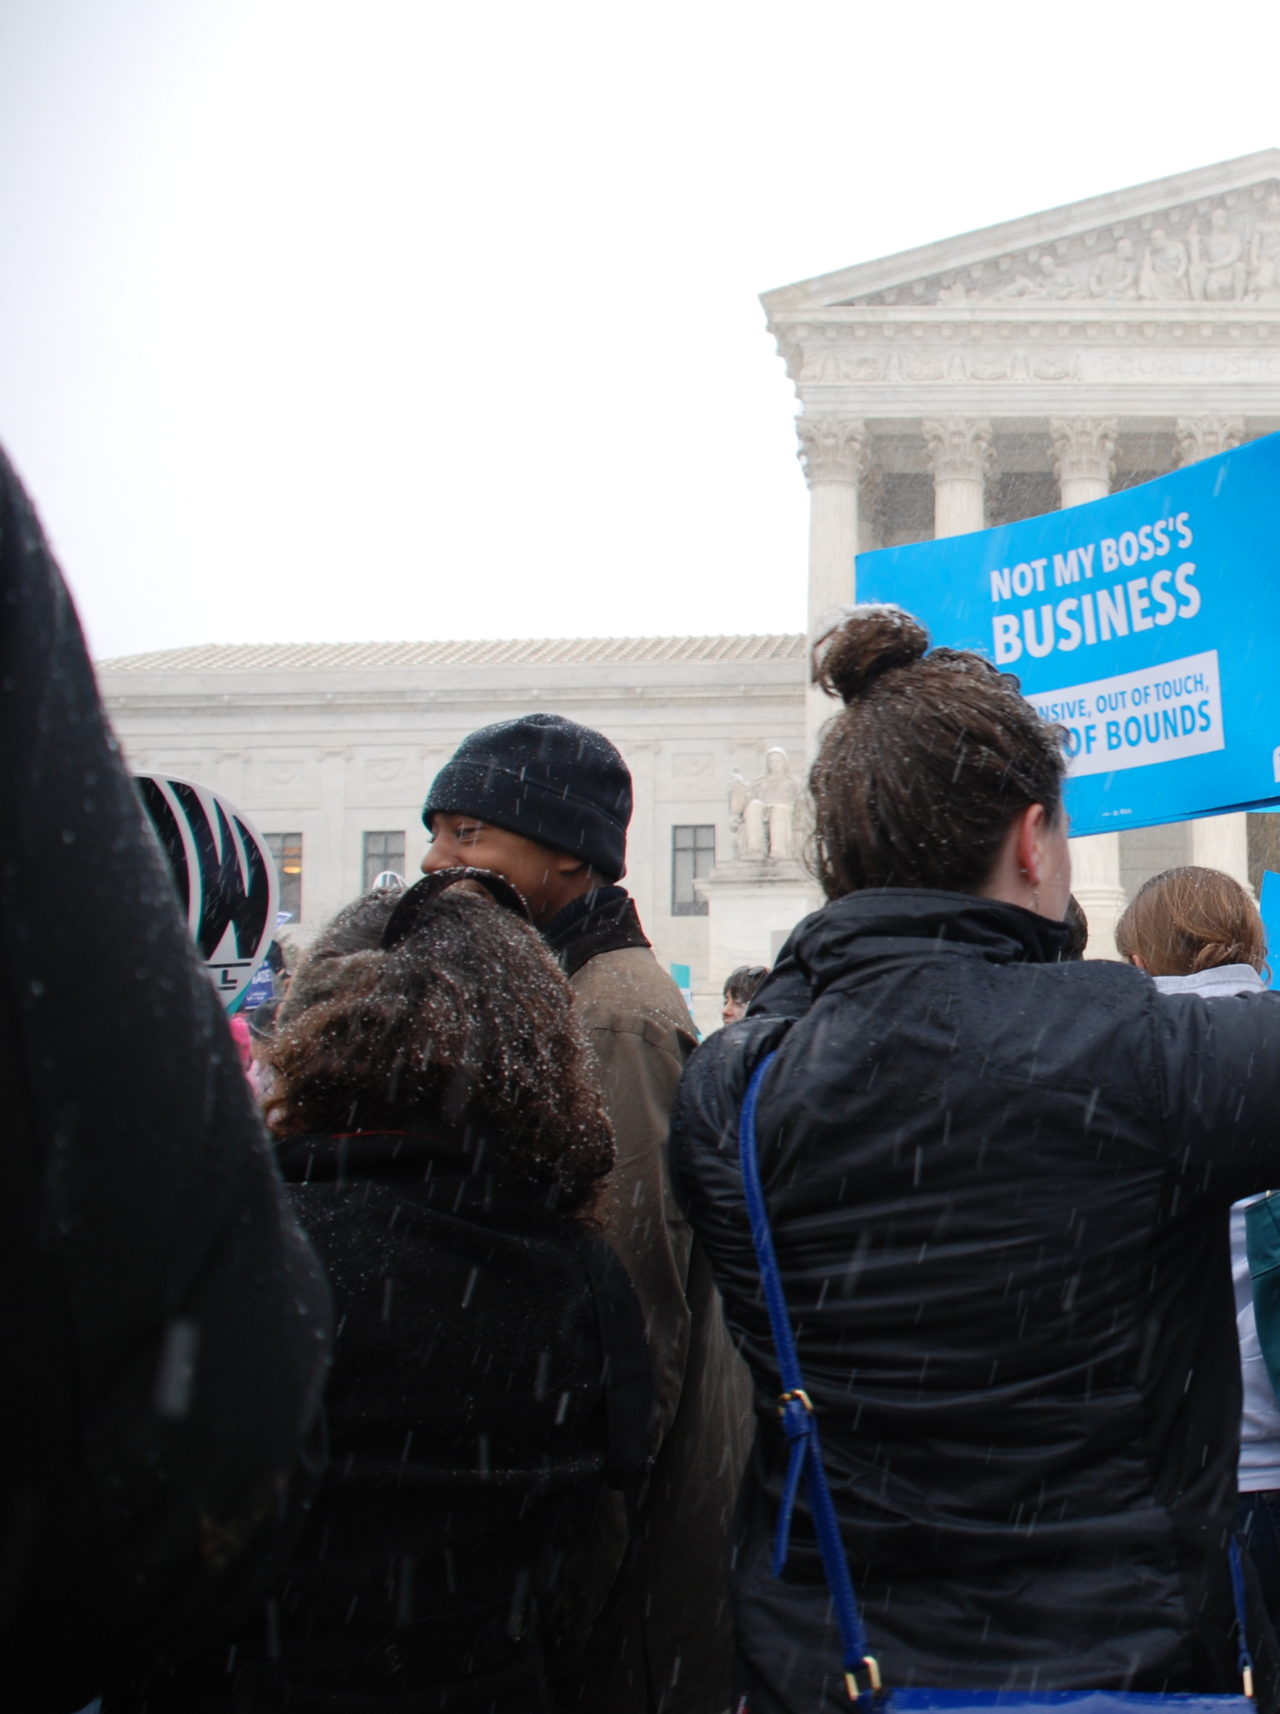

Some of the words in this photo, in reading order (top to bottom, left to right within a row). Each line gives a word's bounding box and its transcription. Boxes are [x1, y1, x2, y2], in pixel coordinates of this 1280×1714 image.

[990, 558, 1048, 602] NOT
[1052, 543, 1096, 588] MY
[1099, 511, 1194, 574] BOSS'S
[991, 561, 1202, 666] BUSINESS
[1037, 699, 1092, 723] NSIVE,
[1095, 690, 1128, 714] OUT
[1131, 685, 1151, 708] OF
[1153, 672, 1210, 702] TOUCH,
[1105, 699, 1211, 752] BOUNDS
